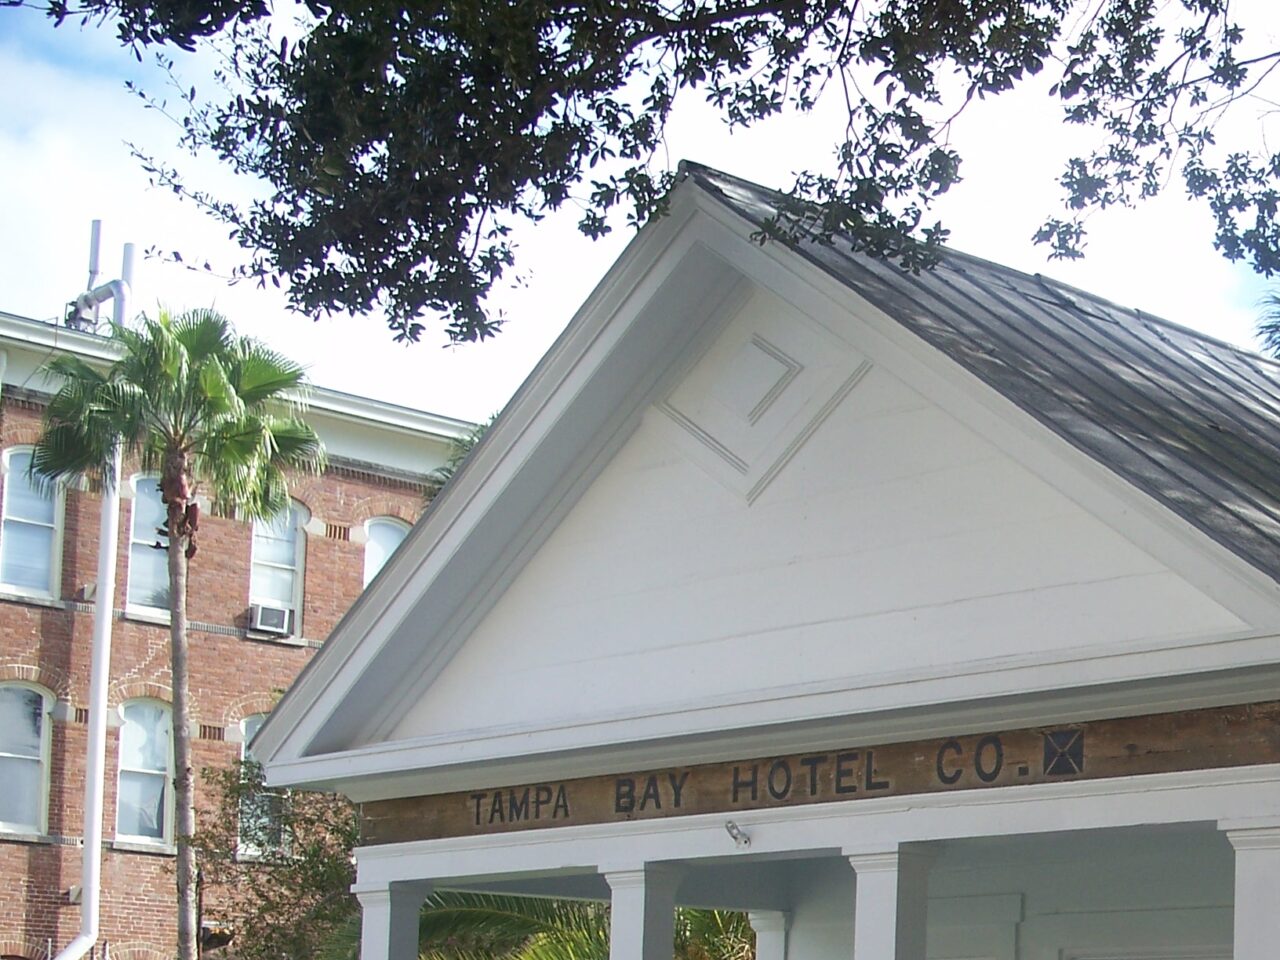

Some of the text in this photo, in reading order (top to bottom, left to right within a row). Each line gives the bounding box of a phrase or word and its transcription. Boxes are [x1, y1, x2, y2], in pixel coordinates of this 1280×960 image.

[470, 735, 1030, 826] TAMPA BAY HOTEL CO.
